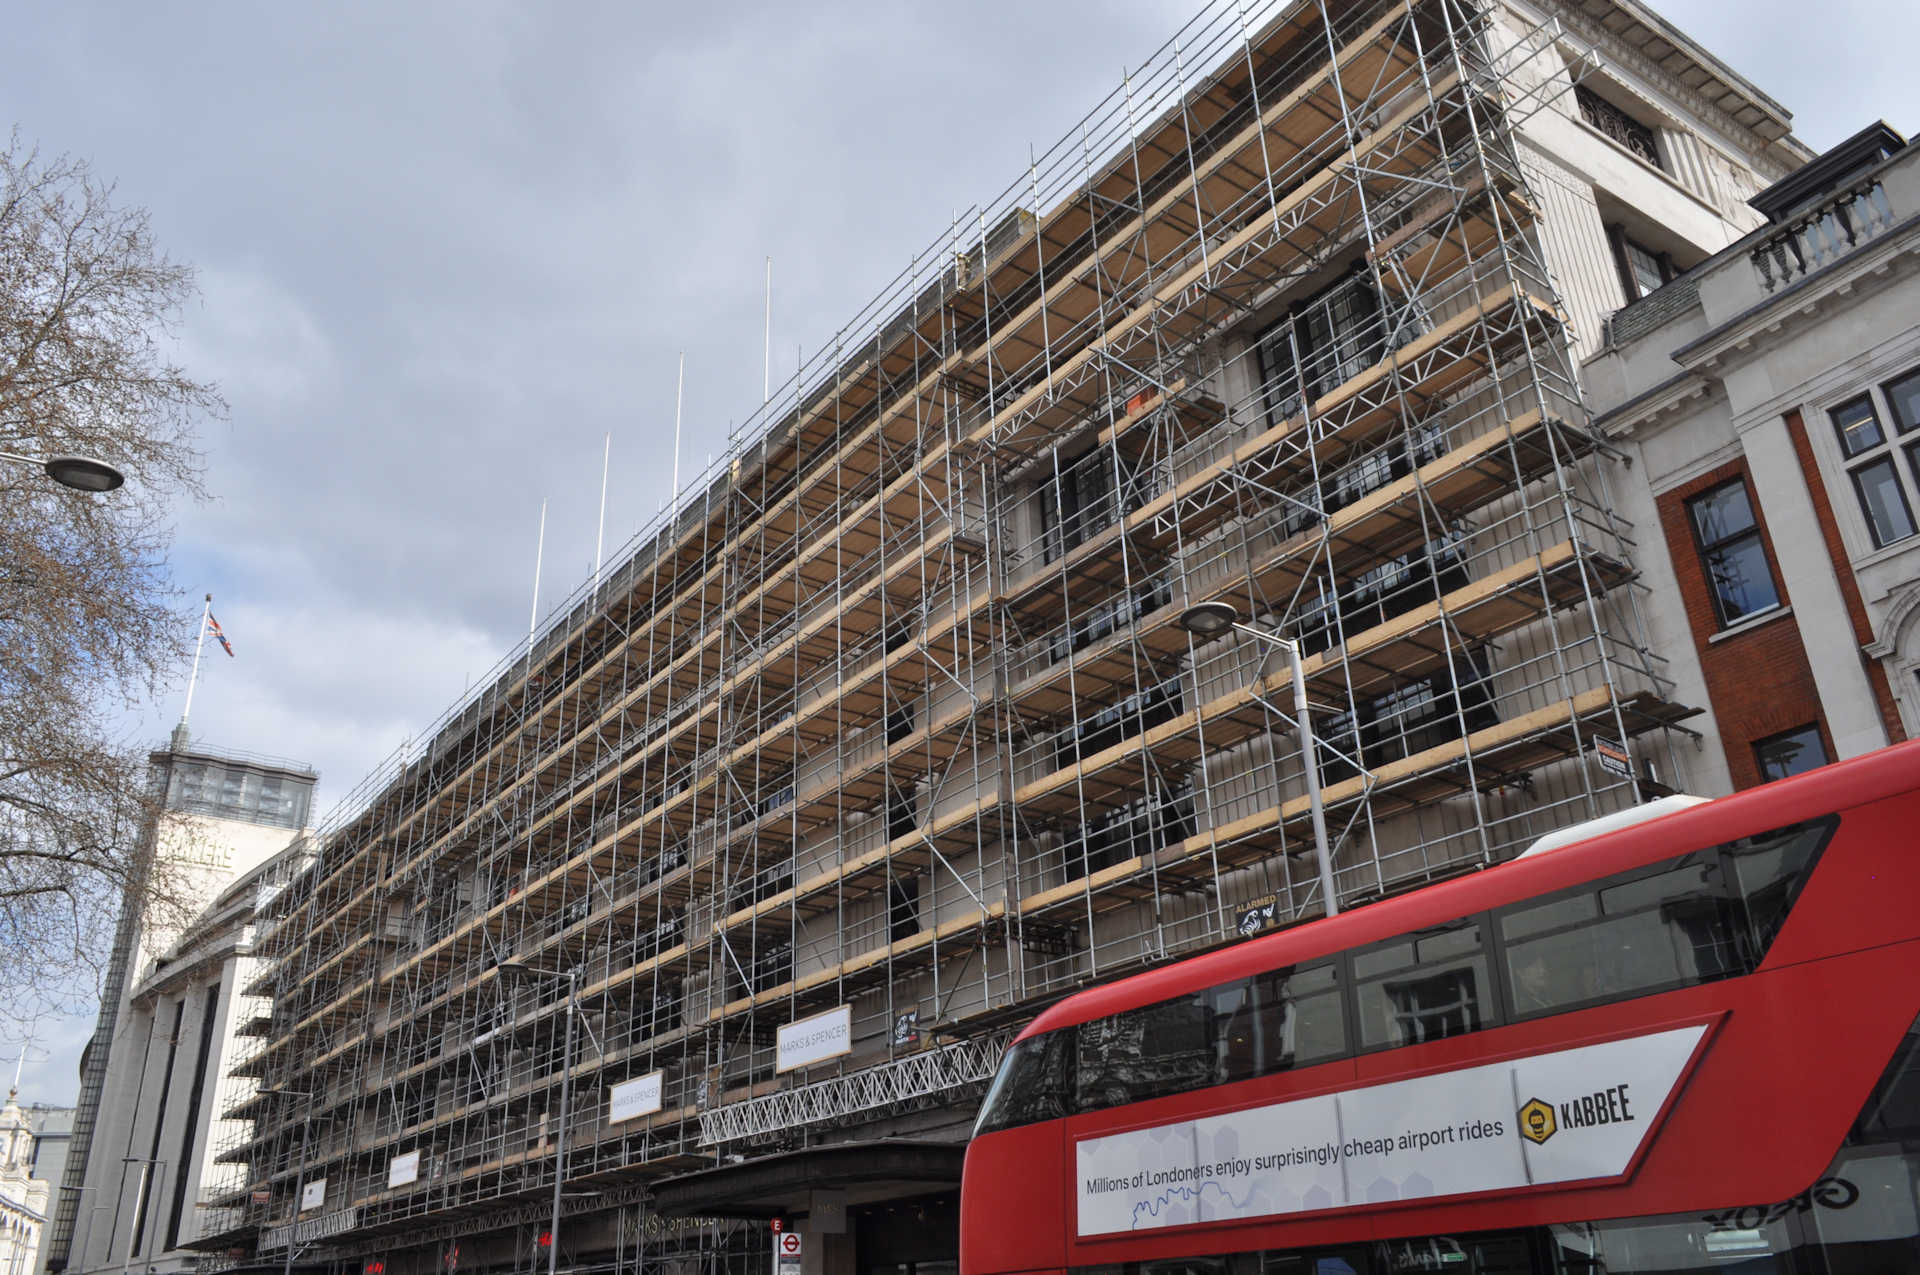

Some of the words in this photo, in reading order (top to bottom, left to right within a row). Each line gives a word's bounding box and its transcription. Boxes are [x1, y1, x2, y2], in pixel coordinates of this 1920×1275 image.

[1236, 894, 1277, 913] ALARMED
[780, 1037, 805, 1054] MARKS
[811, 1023, 847, 1046] SPENCER
[1560, 1083, 1635, 1130] KABBEE
[1086, 1178, 1130, 1194] Millions
[1131, 1172, 1144, 1189] of
[1146, 1164, 1213, 1187] Londoners
[1215, 1157, 1252, 1178] enjoy
[1254, 1142, 1340, 1171] surprisingly
[1343, 1138, 1394, 1158] cheap
[1398, 1125, 1455, 1152] airport
[1458, 1119, 1504, 1142] rides
[774, 1220, 781, 1231] E
